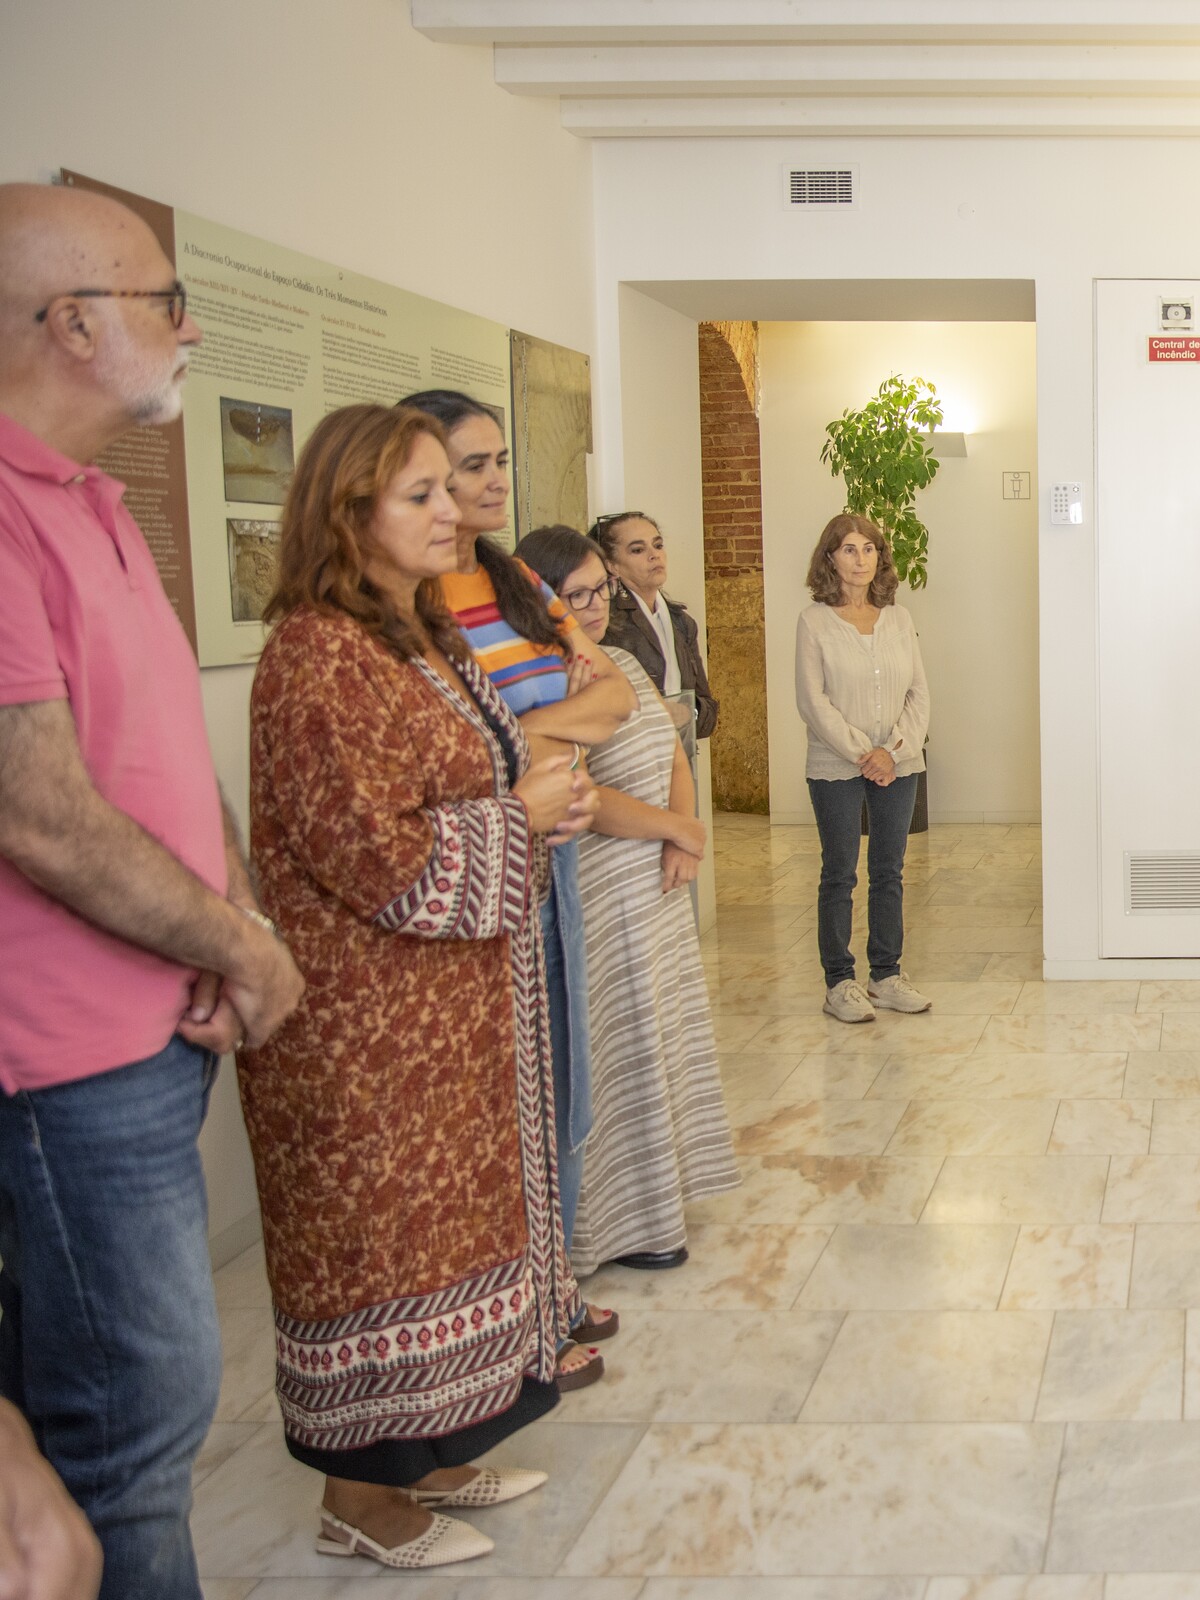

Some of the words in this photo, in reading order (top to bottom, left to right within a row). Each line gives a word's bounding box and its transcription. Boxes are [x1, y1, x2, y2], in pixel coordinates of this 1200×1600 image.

[184, 241, 190, 254] A
[224, 255, 263, 277] Ocupacional
[263, 267, 272, 280] do
[272, 270, 292, 288] Espaço
[337, 292, 363, 308] Momentos
[1152, 340, 1185, 349] Central
[1188, 340, 1200, 349] de
